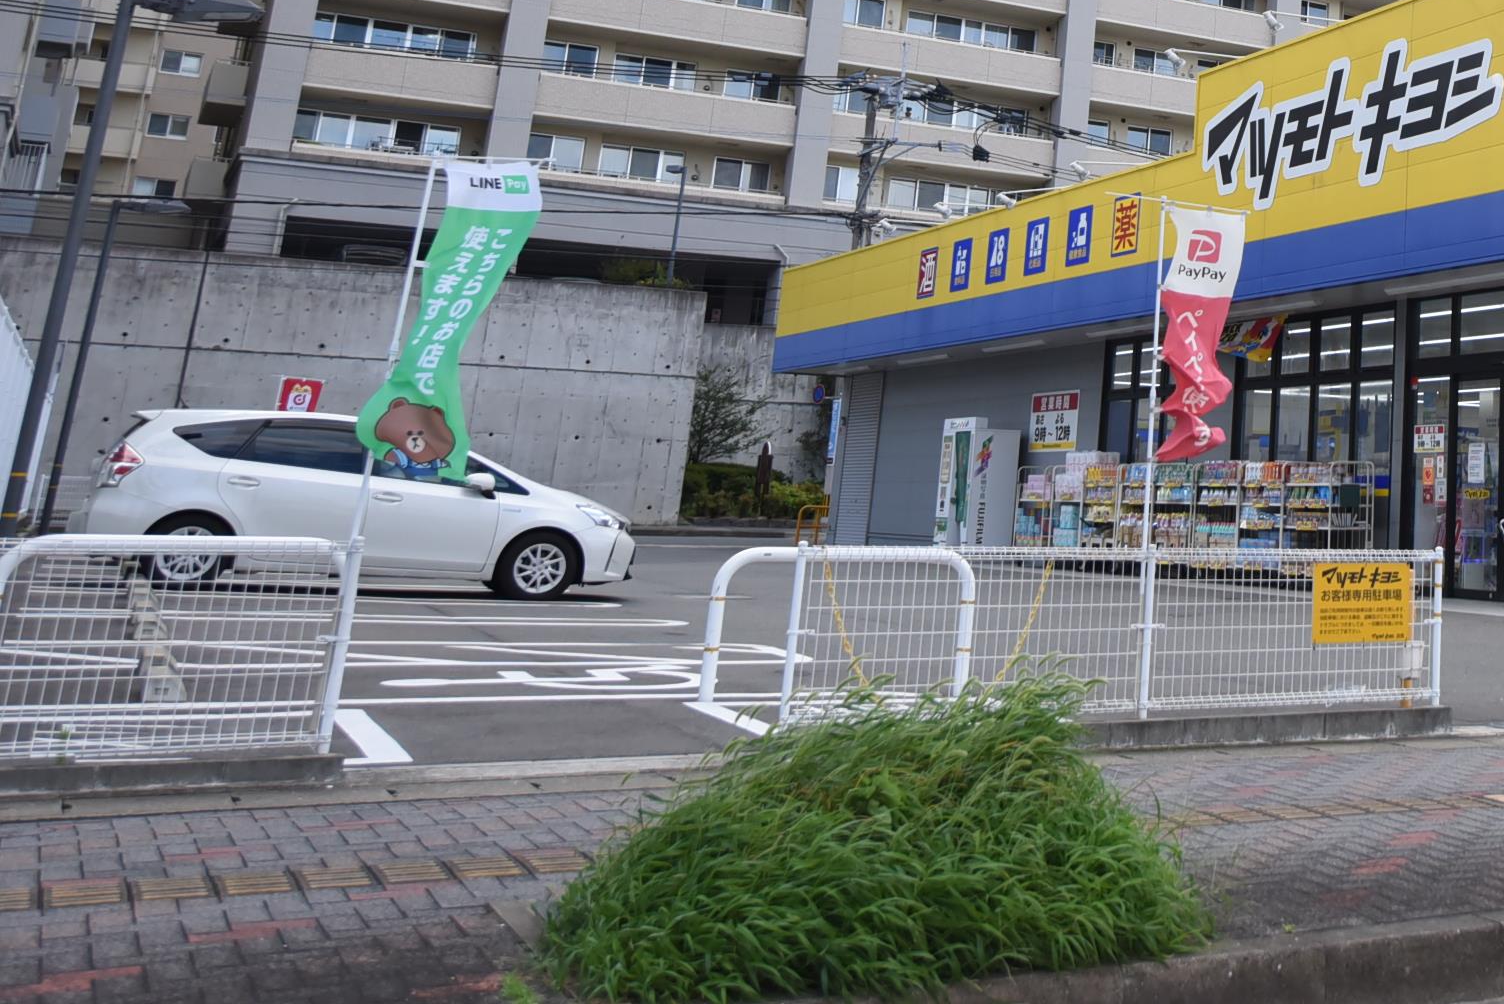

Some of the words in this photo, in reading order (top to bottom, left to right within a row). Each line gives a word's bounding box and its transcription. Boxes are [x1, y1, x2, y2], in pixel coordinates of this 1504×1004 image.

[1207, 49, 1498, 202] マツモトキヨシ
[470, 177, 502, 190] LINE
[506, 178, 527, 191] Pay
[1114, 199, 1138, 251] 薬
[918, 252, 937, 294] 酒
[1178, 263, 1227, 284] PayPay
[415, 226, 513, 396] こちらのお店で
[975, 501, 986, 545] FUJIFILM
[1321, 588, 1403, 602] お客様専用駐車場
